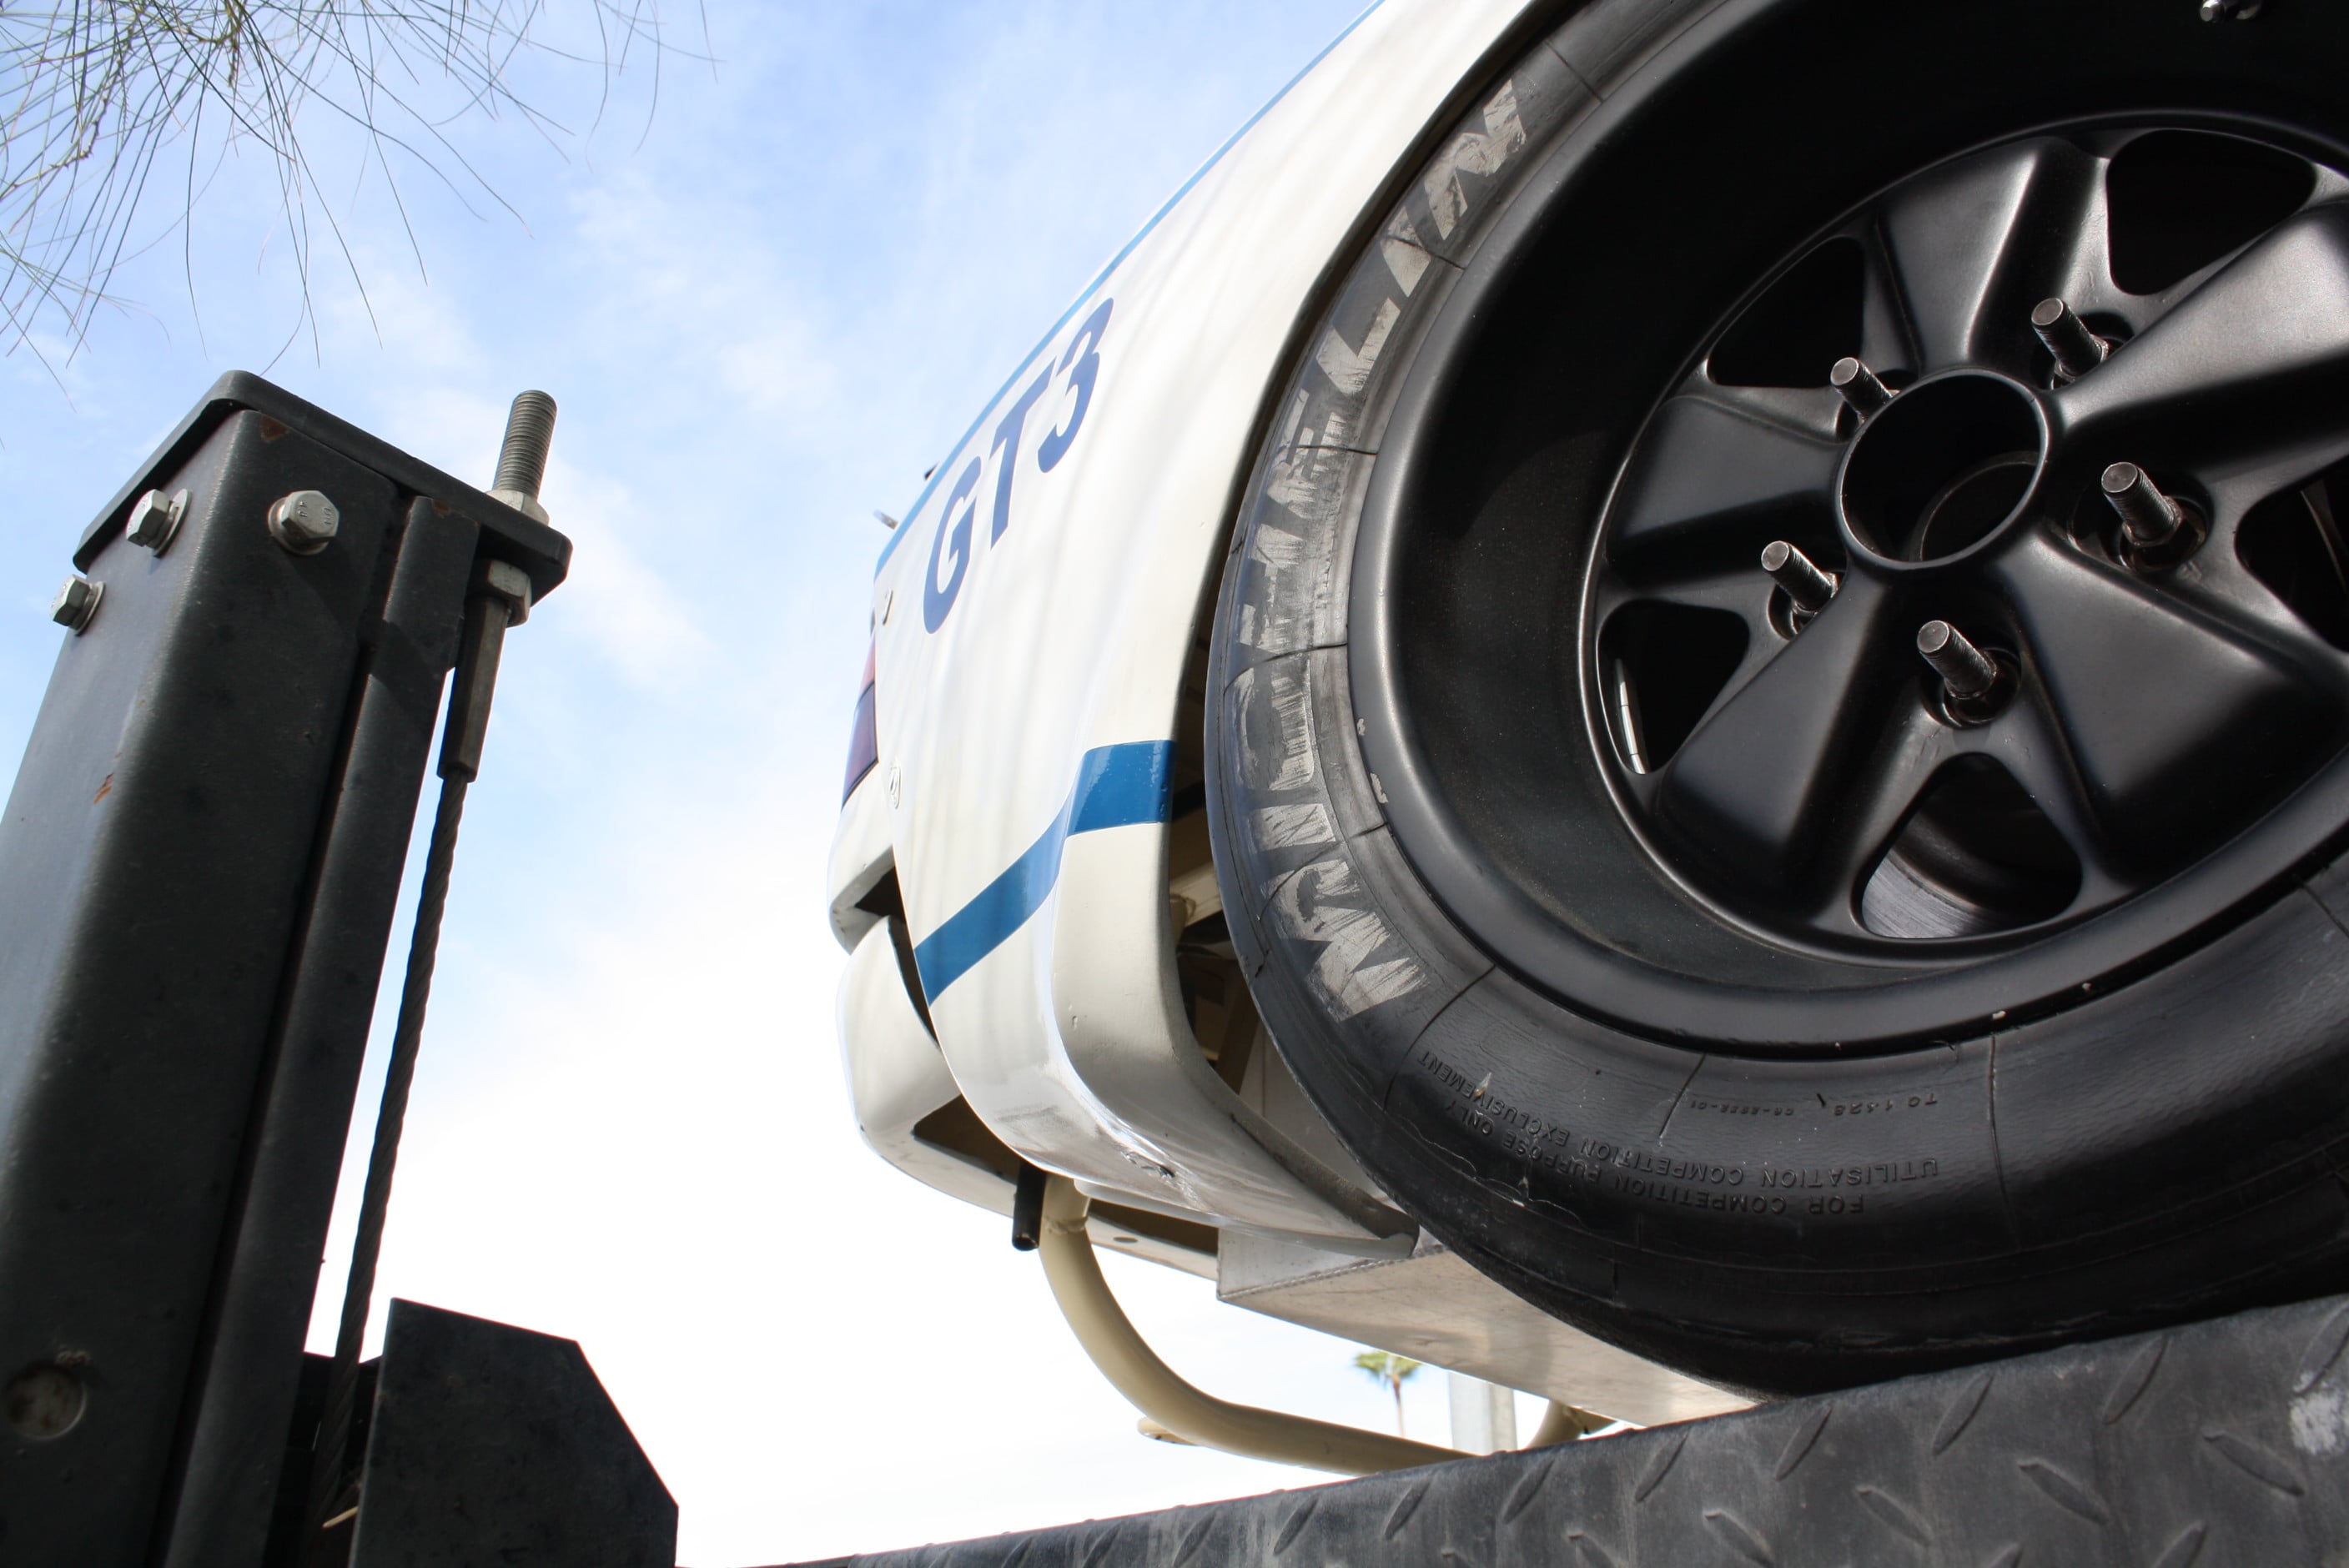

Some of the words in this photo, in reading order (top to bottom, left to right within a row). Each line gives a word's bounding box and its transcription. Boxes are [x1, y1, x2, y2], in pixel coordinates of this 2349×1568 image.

[923, 297, 1114, 634] GT3
[1225, 78, 1528, 1023] MICHELIN
[1416, 1050, 1571, 1148] EXCLUSIVEMENT
[1446, 1098, 1495, 1136] ONLY
[1501, 1132, 1602, 1184] PURPOSE
[1579, 1137, 1745, 1187] COMPETITION
[1760, 1158, 1939, 1189] UTILISATION
[1613, 1172, 1788, 1215] COMPETITION
[1808, 1193, 1865, 1214] FOR
